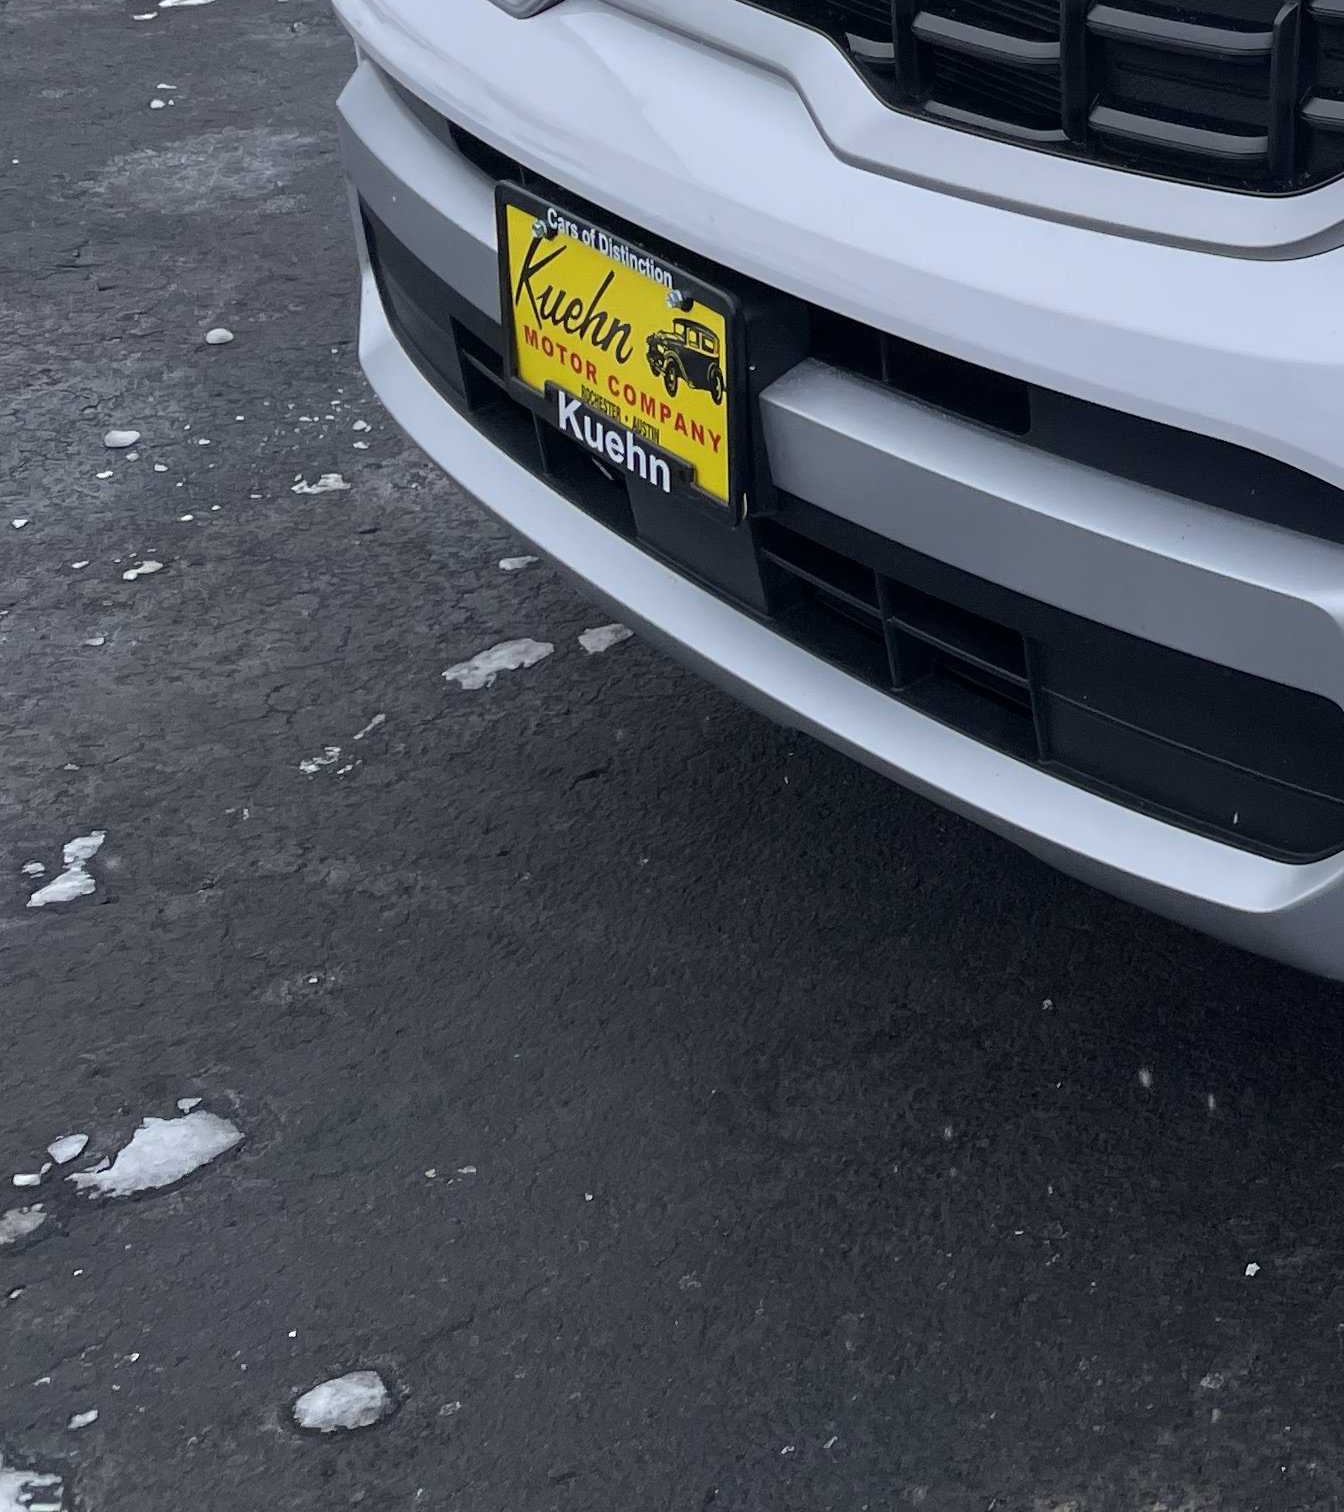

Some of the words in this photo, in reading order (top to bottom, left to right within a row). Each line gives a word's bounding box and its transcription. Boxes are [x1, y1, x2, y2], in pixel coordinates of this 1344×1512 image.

[515, 236, 634, 364] Kuehn
[547, 208, 579, 239] Cars
[582, 229, 596, 250] of
[598, 232, 673, 289] Distinction
[523, 325, 598, 386] MOTOR
[608, 374, 722, 454] COMPANY
[557, 389, 671, 494] Kuehn
